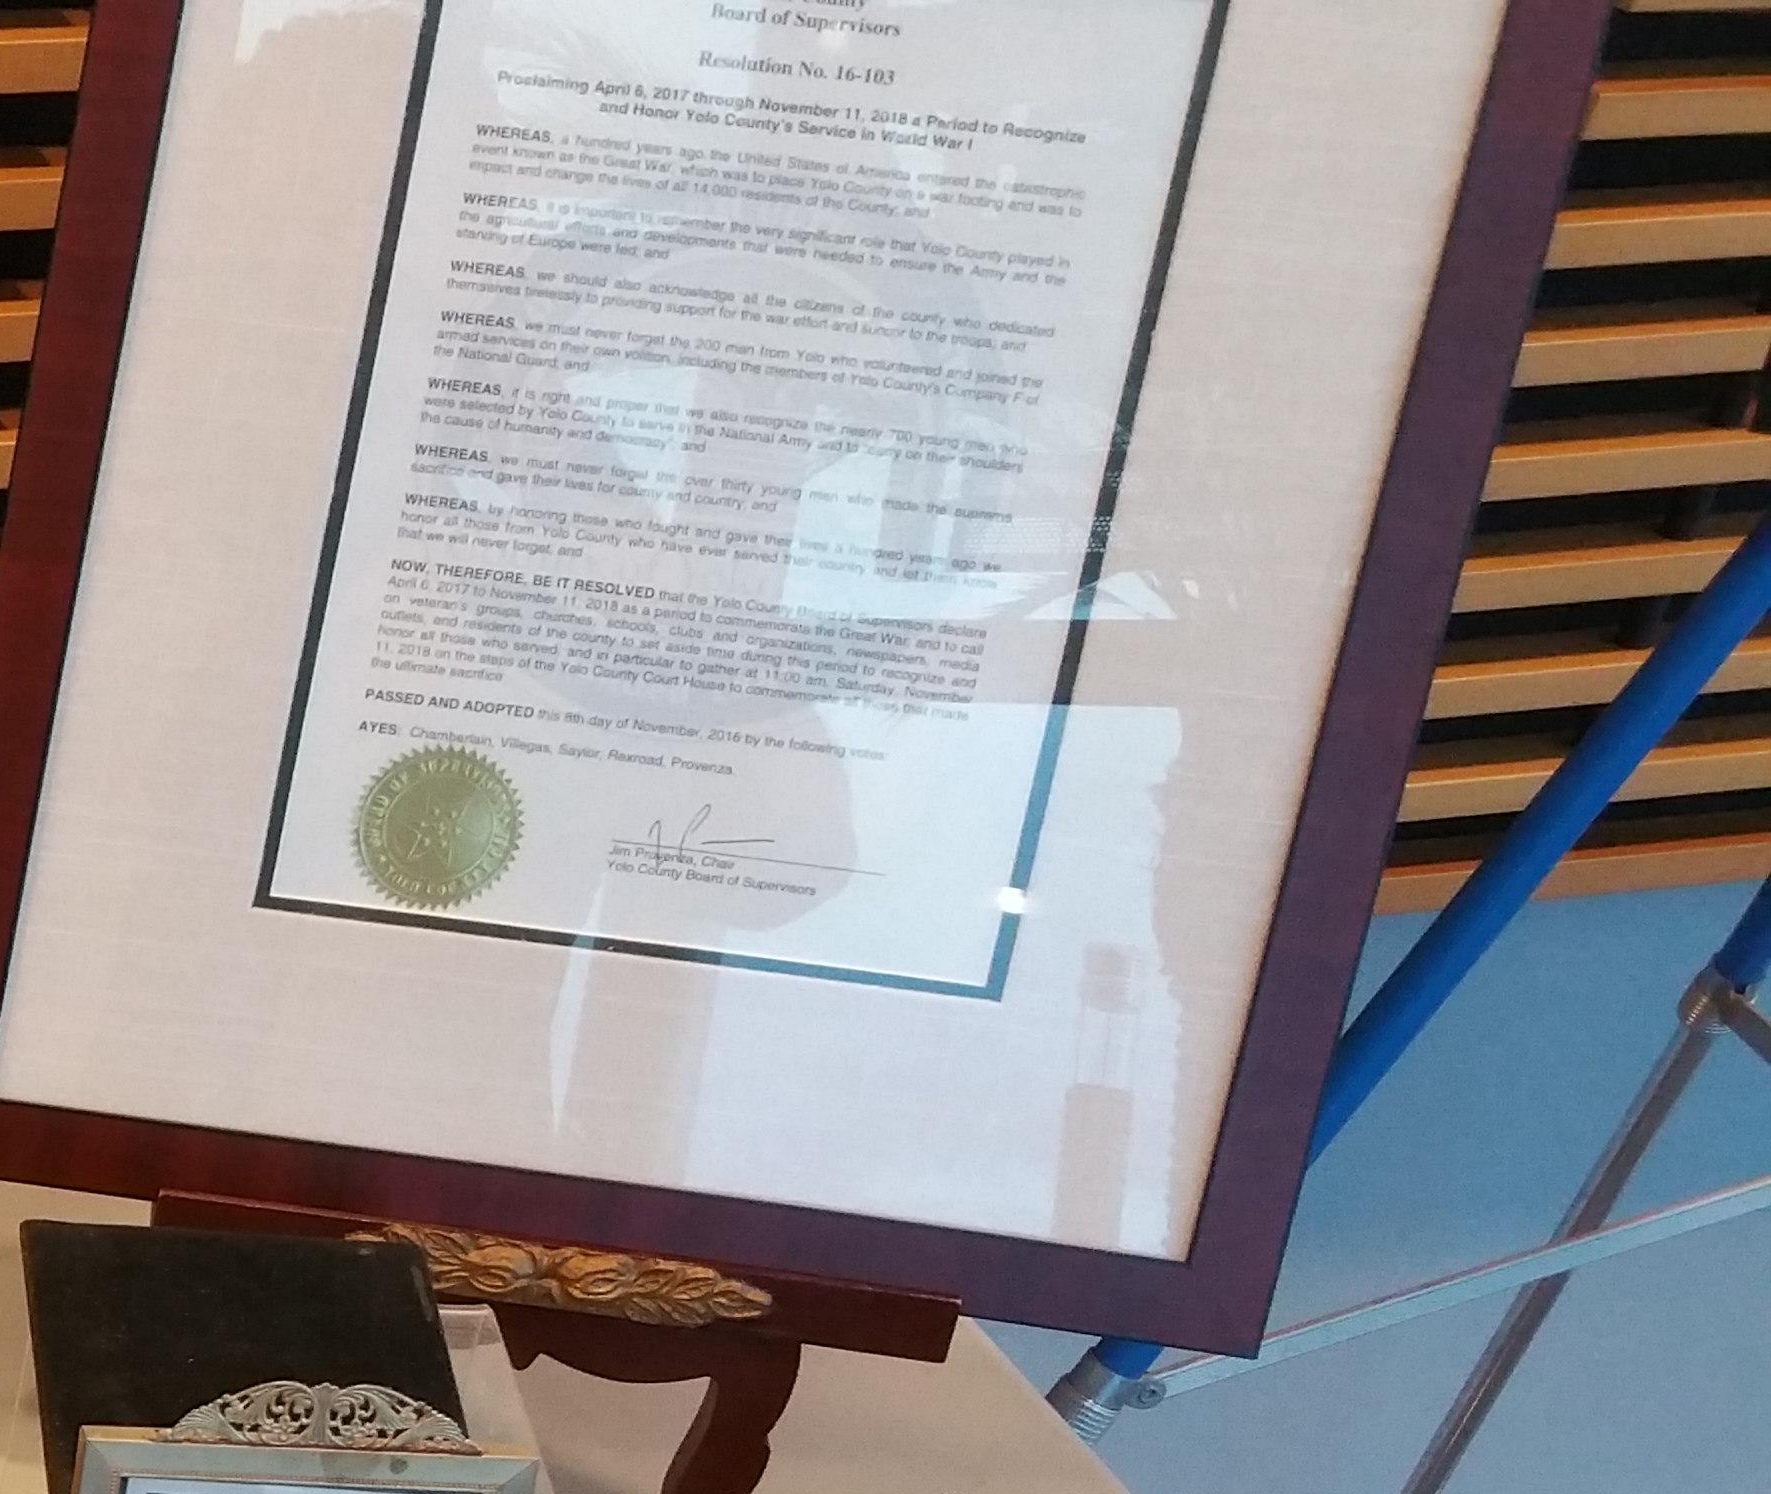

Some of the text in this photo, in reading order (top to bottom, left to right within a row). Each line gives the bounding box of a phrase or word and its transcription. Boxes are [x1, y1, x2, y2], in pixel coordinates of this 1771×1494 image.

[711, 4, 900, 37] Board of Supervisors
[698, 52, 895, 84] Resolution No. 16-103
[497, 70, 1086, 145] Proclaiming April 6, 2017 through November 11, 2018 a Period to Recognize
[599, 100, 629, 115] and
[633, 103, 679, 120] Honor
[684, 109, 719, 124] Yolo
[723, 113, 793, 134] County's
[798, 120, 856, 138] Service
[860, 127, 876, 140] in
[880, 129, 927, 145] World
[932, 134, 963, 149] War
[390, 558, 655, 600] NOW, THEREFORE, BE IT RESOLVED
[364, 688, 740, 744] PASSED AND ADOPTED day of November, 2016
[358, 720, 400, 737] AYES:
[409, 726, 495, 749] Chamberlain,
[499, 736, 550, 757] Villegas,
[608, 843, 631, 858] Jim
[700, 855, 735, 871] Chair
[606, 859, 817, 898] Yolo County Board of Supervisors
